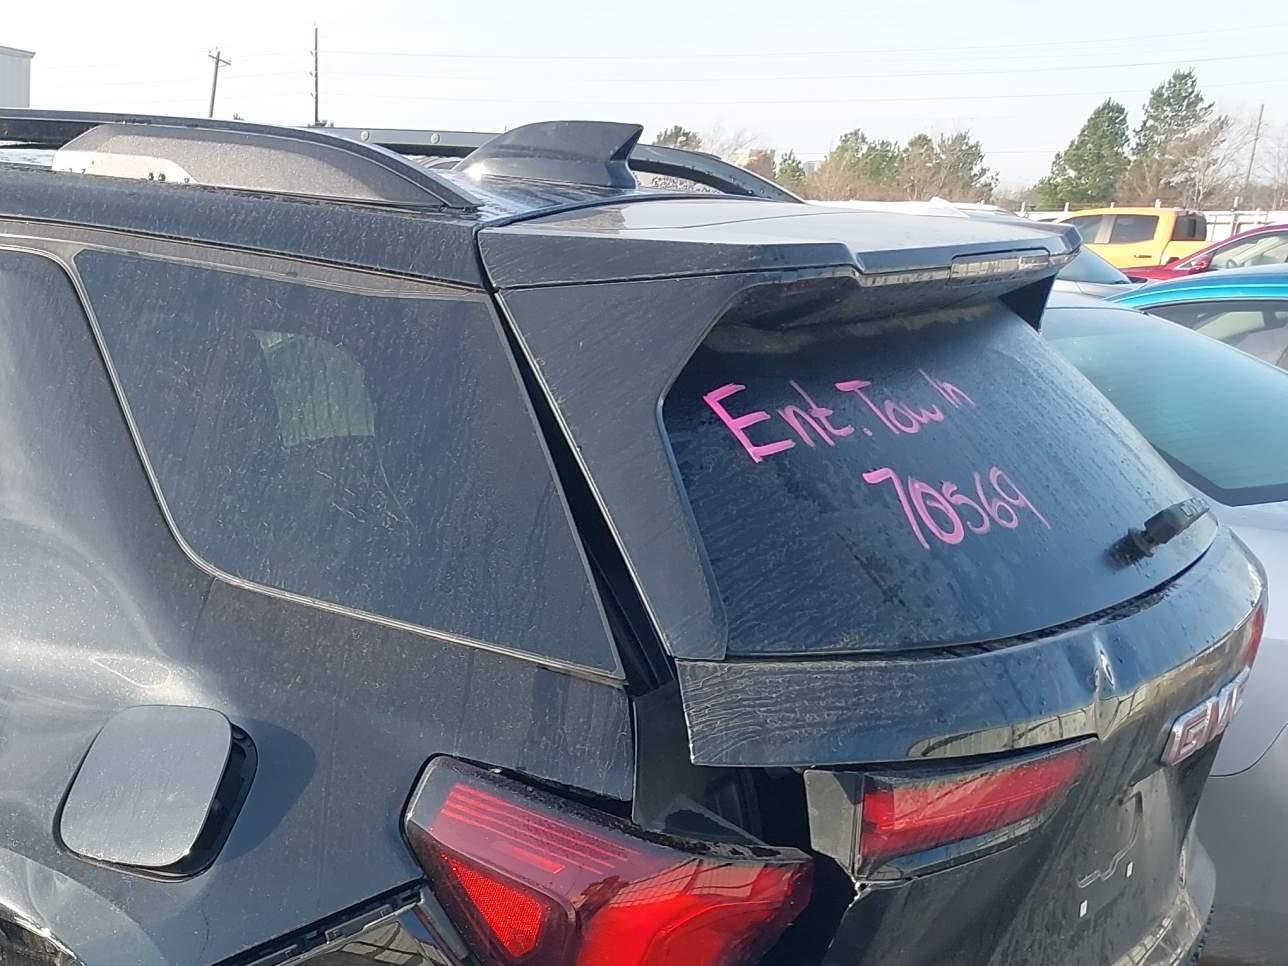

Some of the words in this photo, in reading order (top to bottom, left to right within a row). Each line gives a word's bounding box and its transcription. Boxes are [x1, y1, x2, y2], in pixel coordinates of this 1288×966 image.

[703, 380, 873, 463] Ent.
[834, 379, 944, 436] Tow
[861, 466, 1051, 549] 70569
